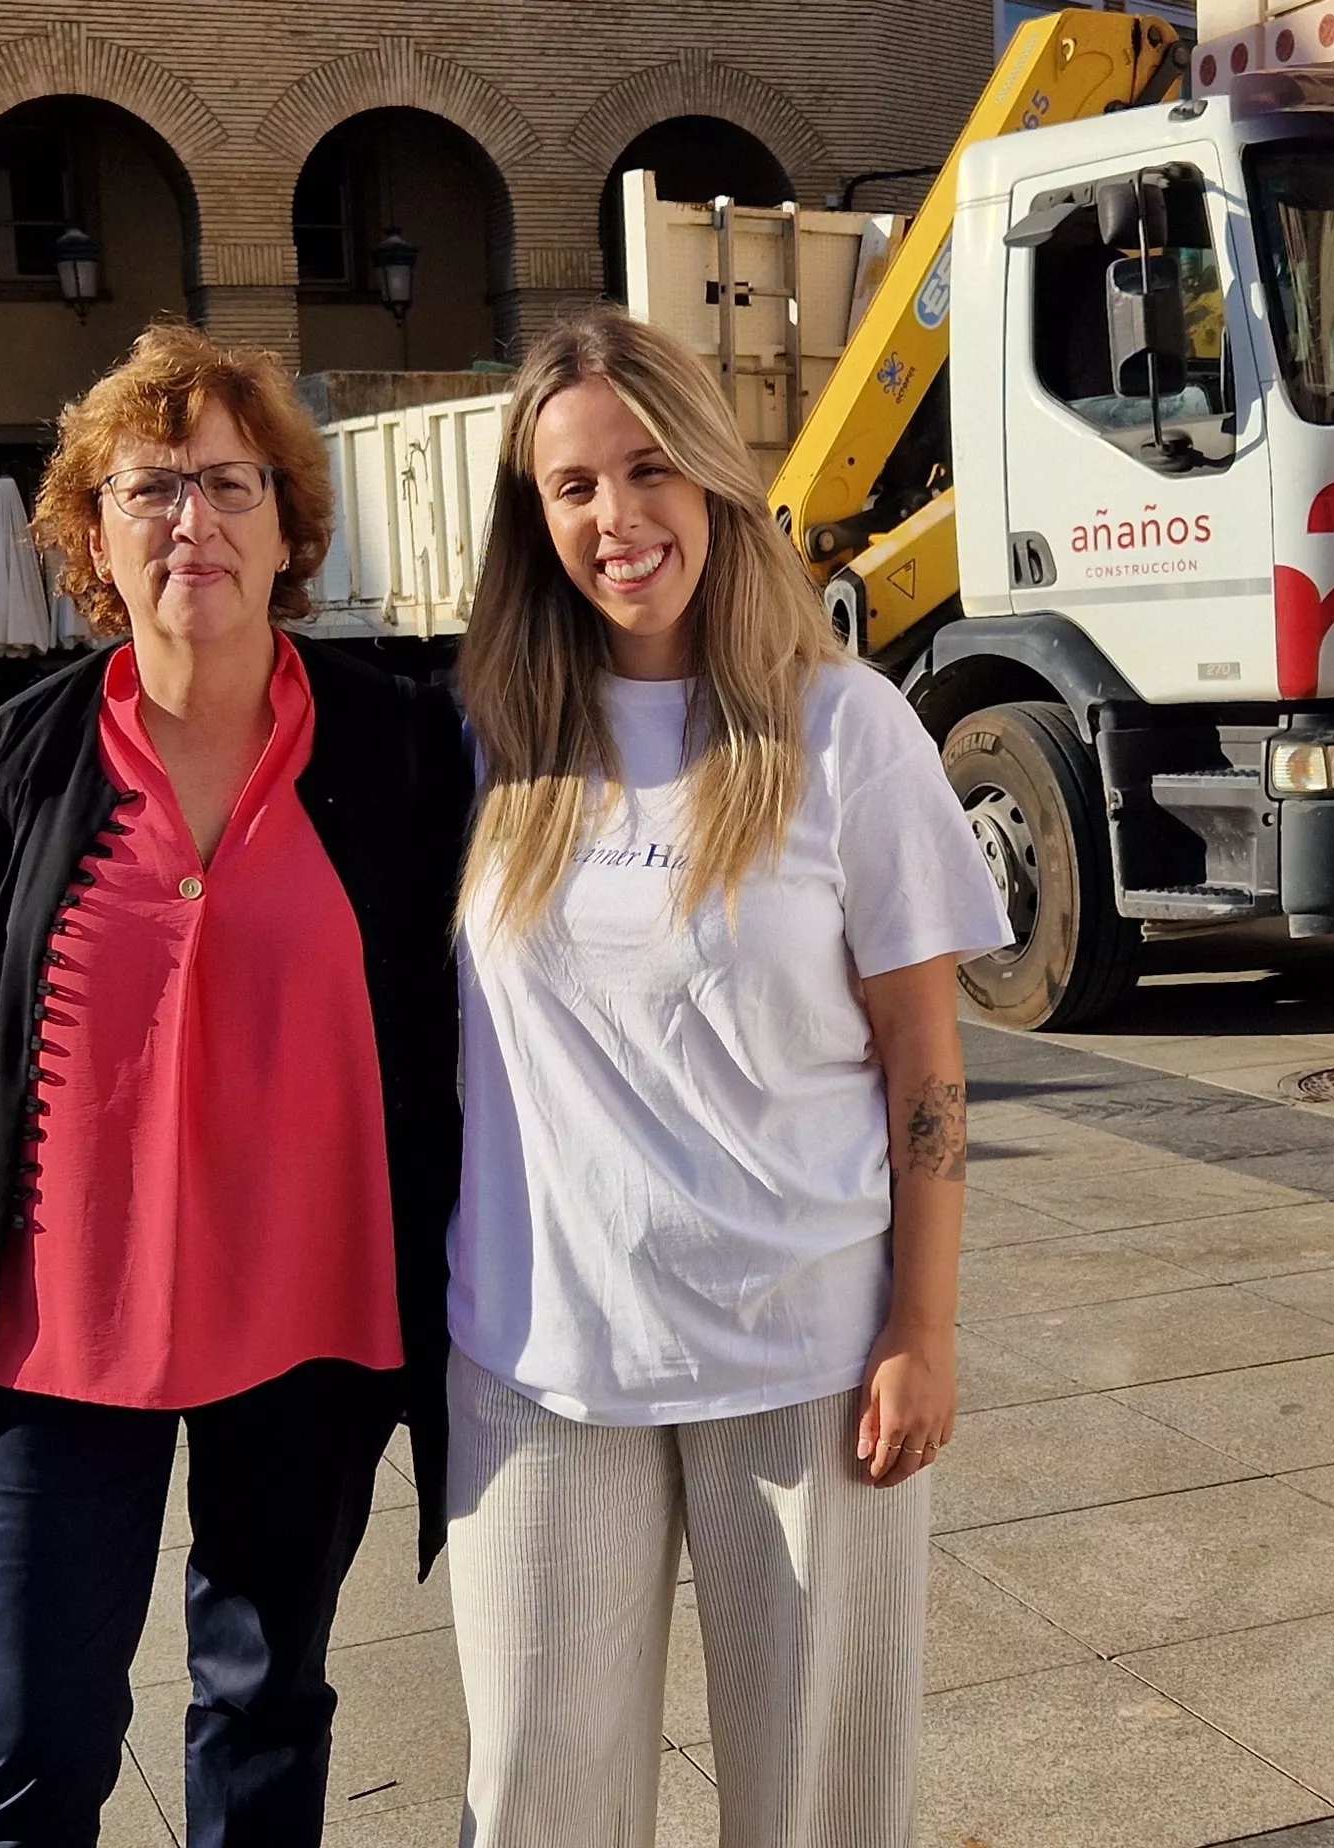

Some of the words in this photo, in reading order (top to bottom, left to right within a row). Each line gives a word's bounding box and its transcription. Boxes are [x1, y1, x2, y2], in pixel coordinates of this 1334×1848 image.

[1015, 88, 1050, 130] 65
[1071, 504, 1212, 553] añaños
[1086, 558, 1198, 578] CONSTRUCCIÓN
[946, 732, 997, 767] CHELIN
